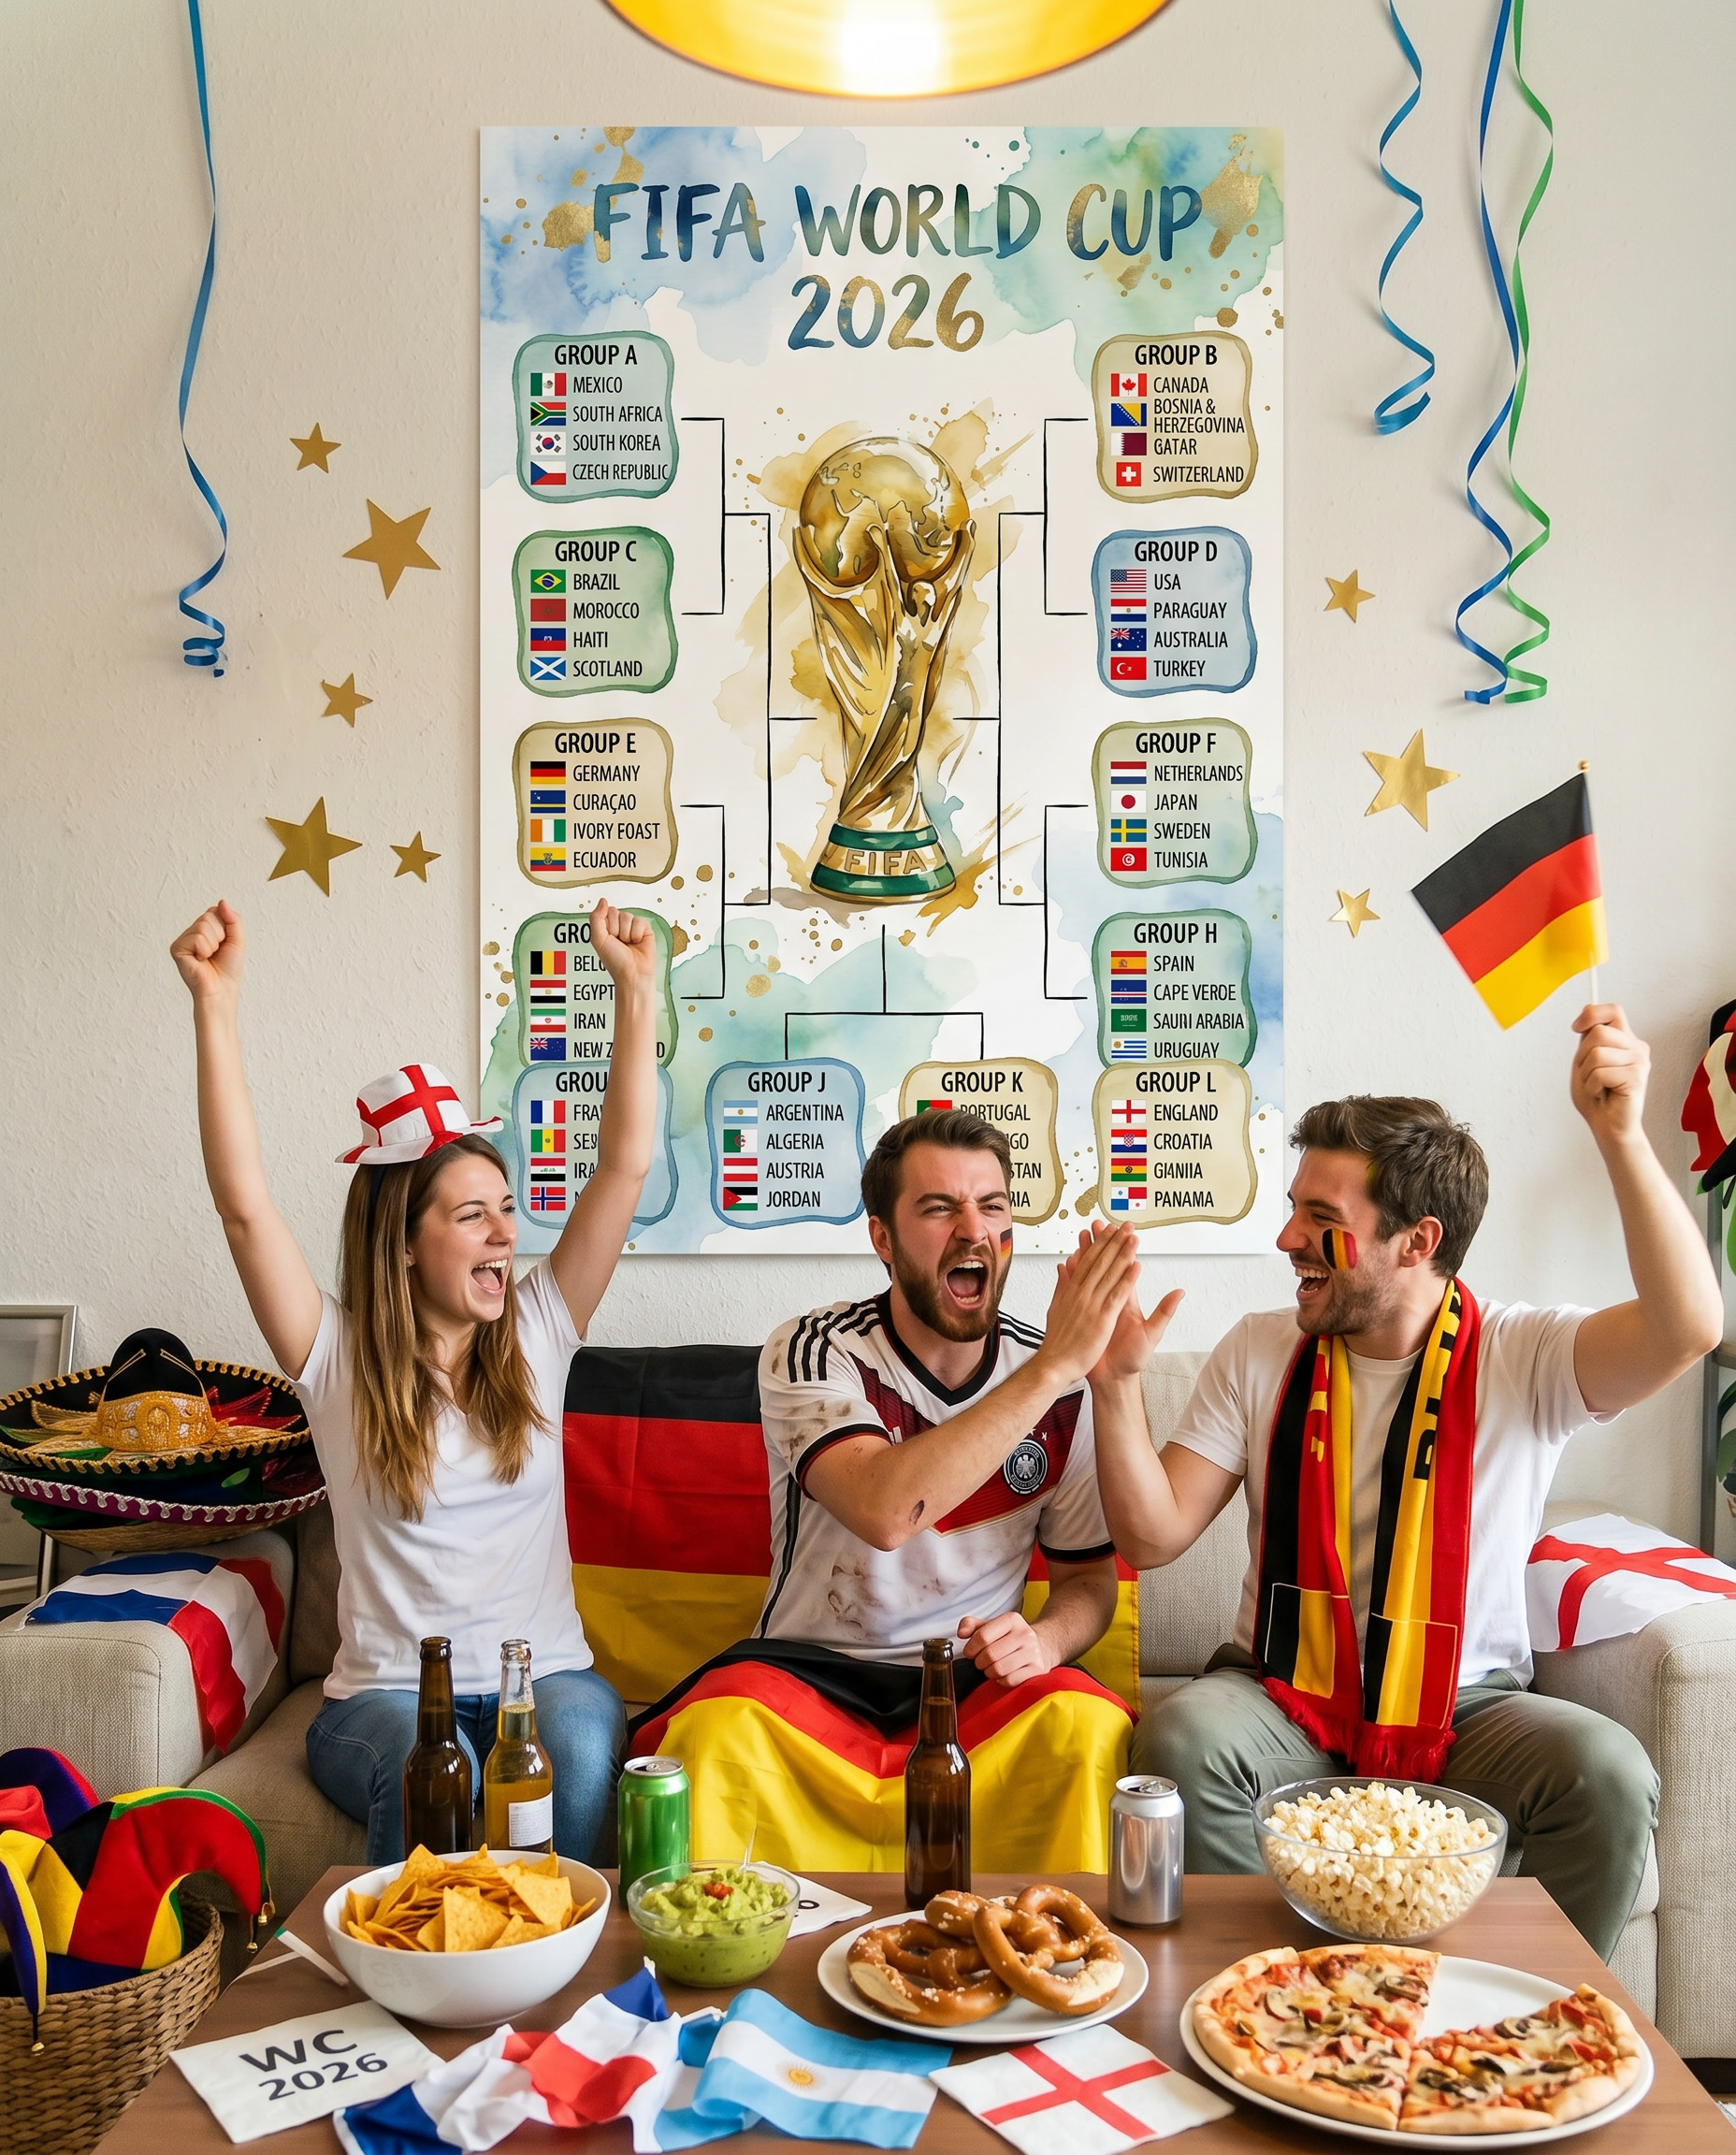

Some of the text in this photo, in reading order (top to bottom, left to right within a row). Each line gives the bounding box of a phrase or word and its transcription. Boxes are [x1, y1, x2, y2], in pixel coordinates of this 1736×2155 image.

[593, 182, 1203, 263] FIFA WORLD CUP
[788, 272, 985, 352] 2026
[555, 345, 637, 365] GROUP A
[1136, 345, 1217, 365] GROUP B
[573, 377, 622, 393] MEXICO
[1154, 377, 1208, 393] CANADA
[1154, 398, 1215, 413] BOSNIA &
[573, 406, 662, 422] SOUTH AFRICA
[1155, 417, 1244, 433] HERZEGOVINA
[573, 435, 660, 451] SOUTH KOREA
[573, 464, 670, 482] CZECH REPUBLIC
[1154, 467, 1243, 482] SWITZERLAND
[556, 541, 636, 561] GROUP C
[1135, 542, 1217, 561] GROUP D
[574, 573, 620, 589] BRAZIL
[1155, 574, 1180, 589] USA
[573, 602, 639, 618] MOROCCO
[1154, 602, 1226, 618] PARAGUAY
[574, 632, 607, 647] HAITI
[1154, 631, 1227, 647] AUSTRALIA
[573, 661, 642, 676] SCOTLAND
[1154, 660, 1205, 676] TURKEY
[556, 733, 636, 753] GROUP E
[1136, 733, 1216, 753] GROUP F
[573, 765, 640, 781] GERMANY
[1155, 766, 1242, 781] NETHERLANDS
[573, 794, 636, 814] CURAÇAO
[1154, 794, 1196, 810] JAPAN
[574, 823, 614, 839] IVORY
[1154, 823, 1209, 839] SWEDEN
[574, 852, 636, 868] ECUADOR
[844, 849, 927, 875] FIFA
[1154, 852, 1208, 868] TUNISIA
[554, 923, 590, 943] GRO
[1135, 923, 1216, 943] GROUP H
[1154, 956, 1194, 971] SPAIN
[574, 985, 615, 1000] EGYPT
[1154, 985, 1188, 1000] CAPE
[574, 1013, 605, 1029] IRAN
[1196, 1014, 1244, 1029] ARABIA
[574, 1042, 602, 1057] NEW
[1155, 1042, 1219, 1058] URUGUAY
[557, 1072, 607, 1092] GROU
[748, 1072, 825, 1092] GROUP J
[942, 1072, 1023, 1092] GROUP K
[1136, 1072, 1216, 1092] GROUP L
[766, 1105, 844, 1121] ARGENTINA
[1155, 1105, 1218, 1121] ENGLAND
[767, 1134, 824, 1150] ALGERIA
[1154, 1134, 1212, 1150] CROATIA
[766, 1163, 824, 1179] AUSTRIA
[767, 1192, 819, 1207] JORDAN
[1155, 1192, 1214, 1207] PANAMA
[239, 2030, 357, 2073] WC
[258, 2052, 388, 2101] 2026
